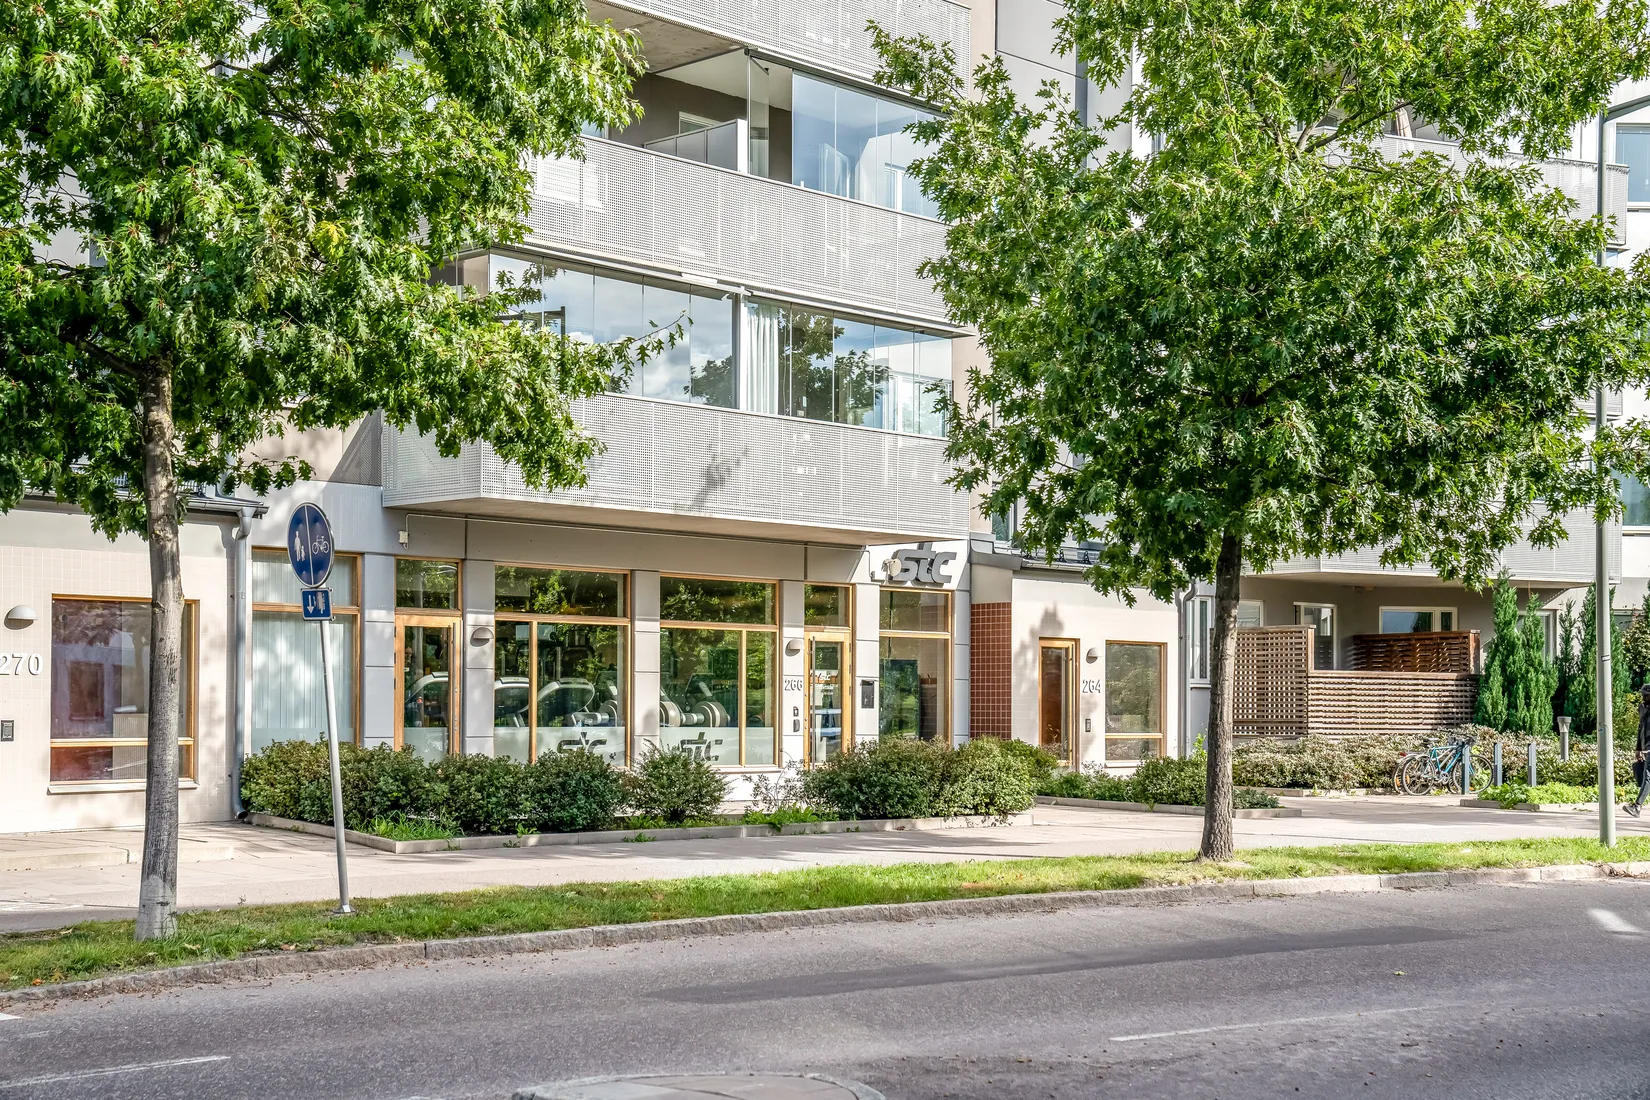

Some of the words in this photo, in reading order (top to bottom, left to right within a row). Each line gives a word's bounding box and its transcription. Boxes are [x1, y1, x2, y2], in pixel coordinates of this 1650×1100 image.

[892, 543, 957, 584] stc
[0, 652, 43, 676] 270
[784, 679, 803, 691] 266
[1082, 679, 1101, 693] 264
